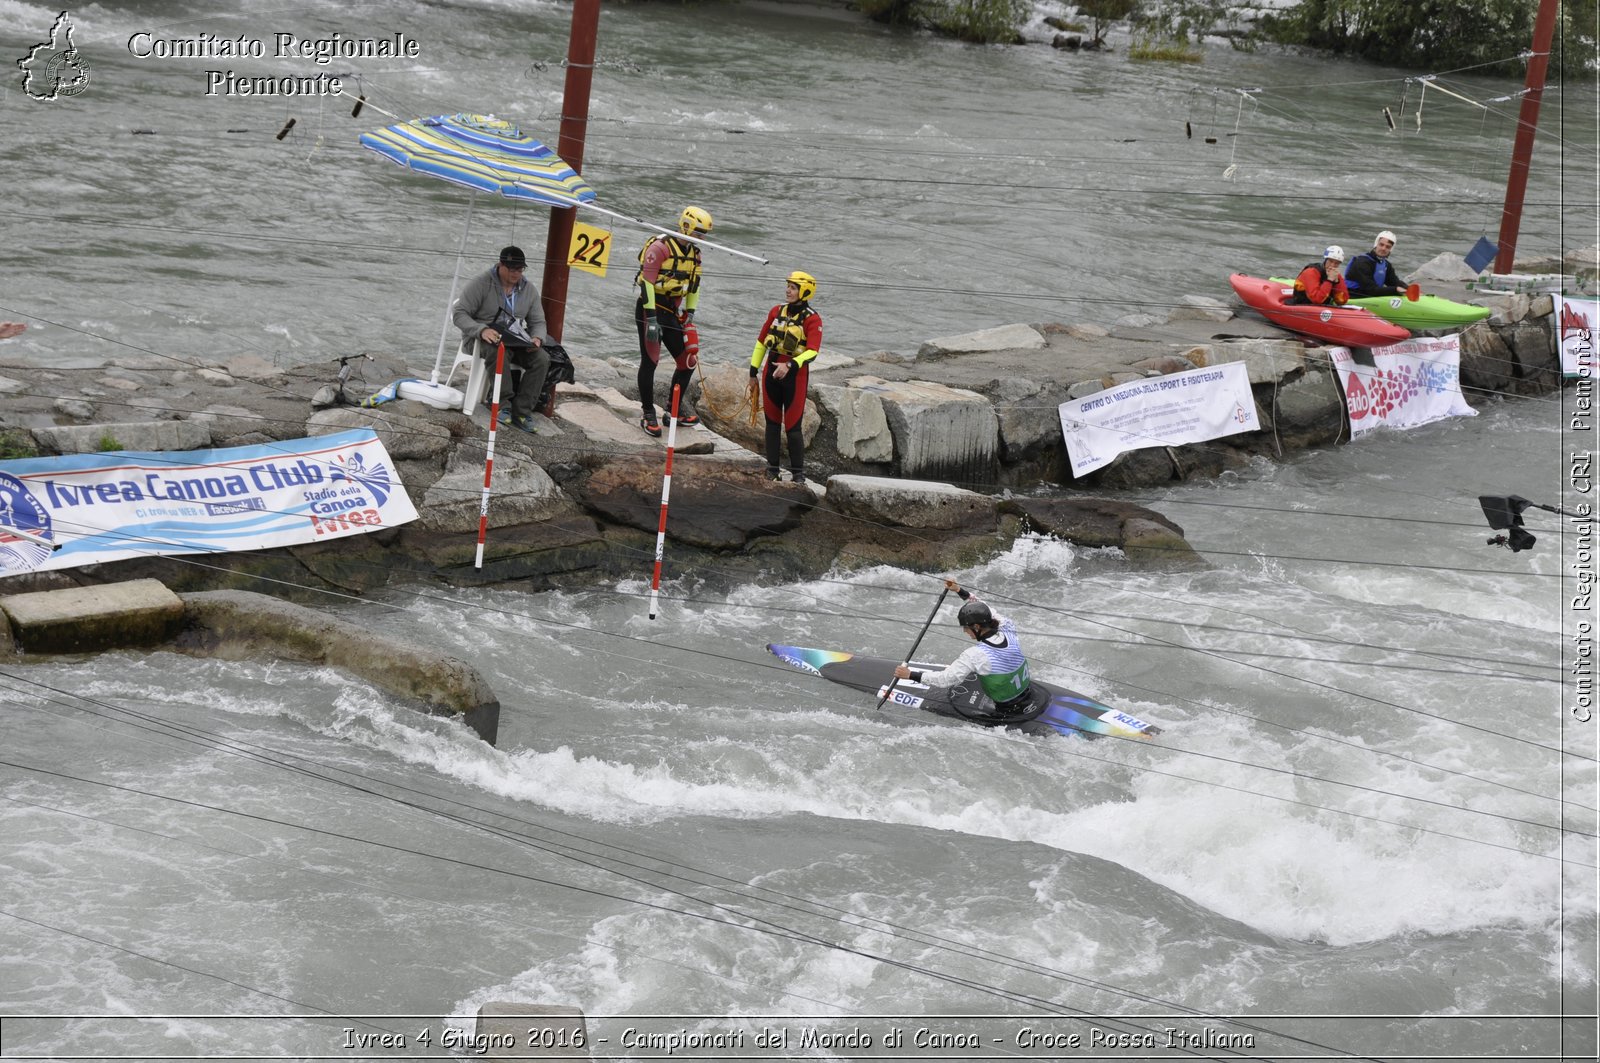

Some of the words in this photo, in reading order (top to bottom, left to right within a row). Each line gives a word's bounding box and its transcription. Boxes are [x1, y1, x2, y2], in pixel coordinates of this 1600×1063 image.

[573, 233, 605, 267] 22
[1081, 398, 1105, 413] CENTRO
[1105, 396, 1113, 405] DI
[1113, 386, 1142, 402] MEDICINA
[1160, 379, 1180, 391] SPORT
[1182, 378, 1187, 386] E
[1188, 371, 1224, 385] FISIOTERAPIA
[1347, 389, 1369, 414] aido
[45, 480, 144, 509] Ivrea
[145, 473, 250, 501] Canoa
[249, 460, 325, 492] Club
[303, 488, 338, 502] Stadio
[340, 486, 361, 496] della
[24, 493, 48, 524] Club
[135, 509, 147, 519] Ci
[168, 508, 178, 516] su
[178, 507, 197, 516] WEB
[210, 501, 249, 514] facebook
[310, 497, 367, 514] Canoa
[310, 509, 382, 535] Ivrea
[1113, 713, 1147, 729] FFCK
